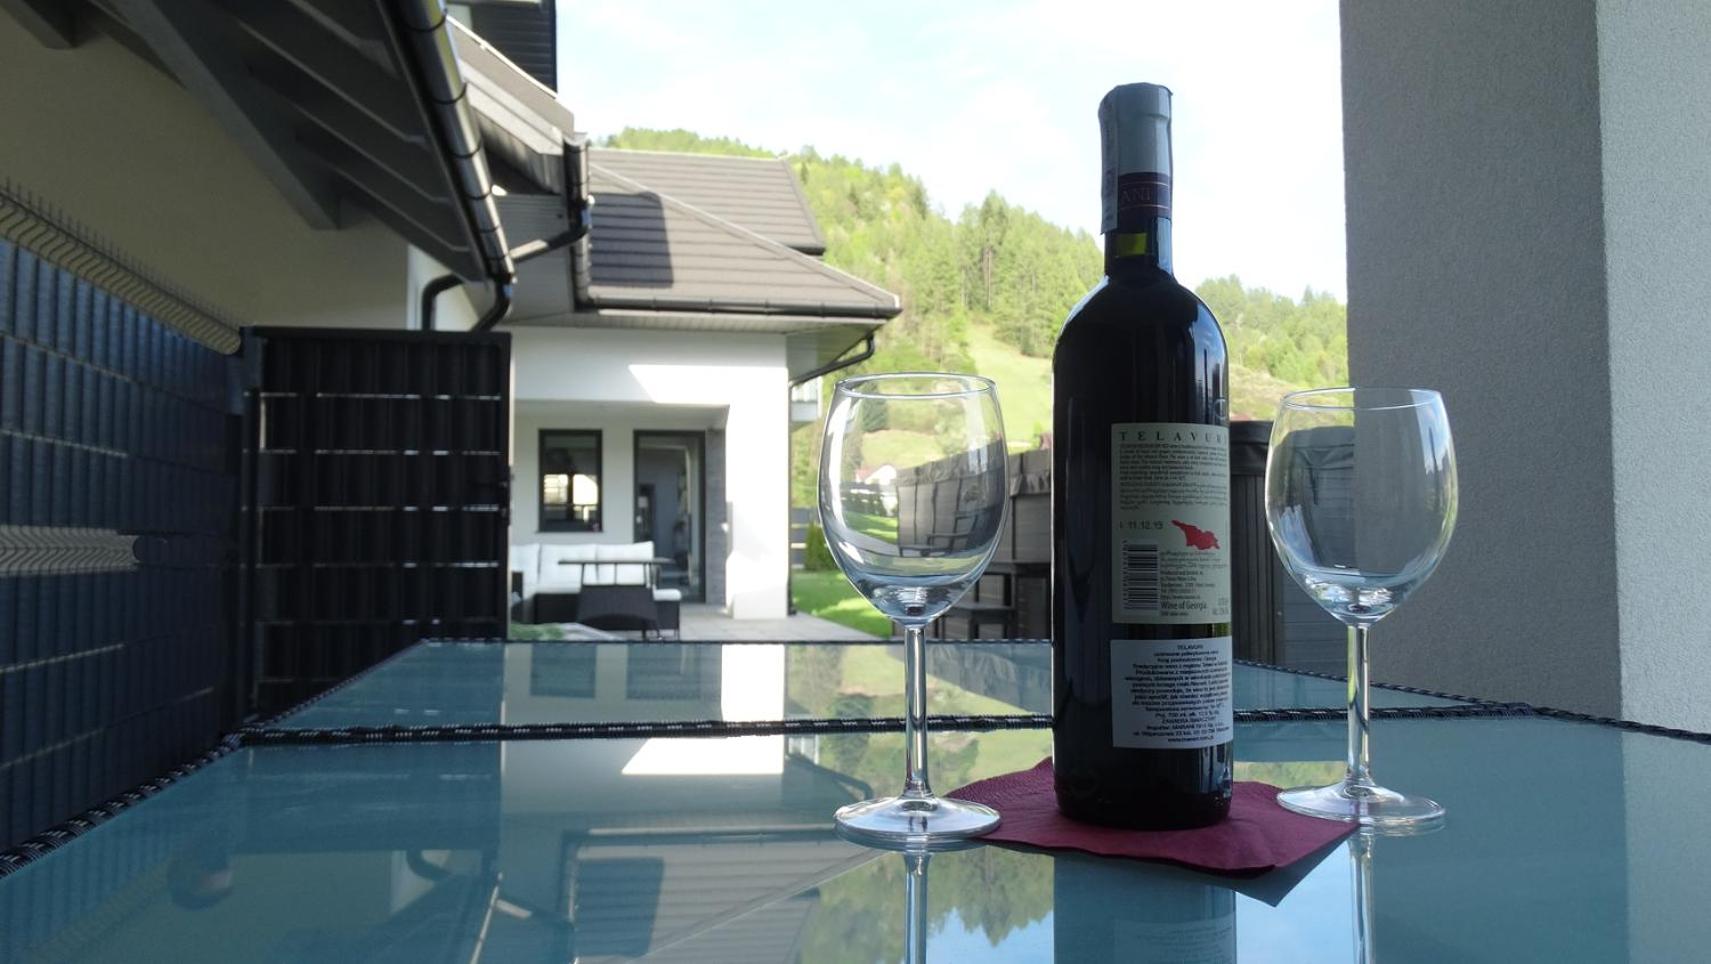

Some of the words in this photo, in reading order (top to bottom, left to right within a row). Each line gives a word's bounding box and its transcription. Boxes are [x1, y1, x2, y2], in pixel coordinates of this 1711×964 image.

[1161, 600, 1178, 609] Wine
[1178, 600, 1185, 609] of
[1185, 600, 1208, 611] Georgia
